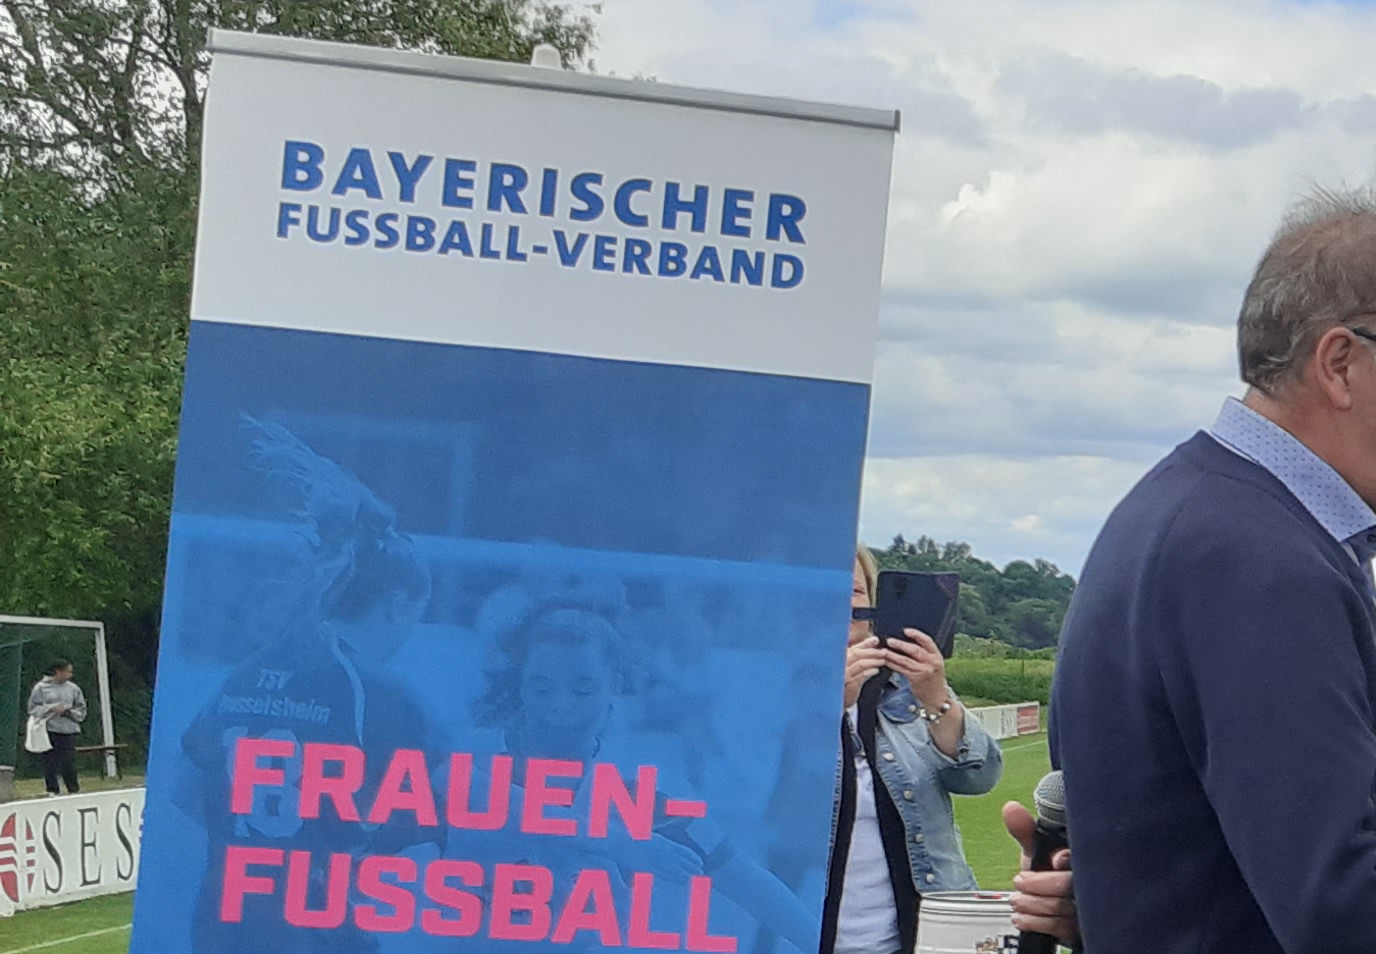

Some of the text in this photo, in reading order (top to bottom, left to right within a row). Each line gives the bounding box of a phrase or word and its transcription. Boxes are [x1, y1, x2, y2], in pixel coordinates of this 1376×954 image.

[281, 140, 807, 244] BAYERISCHER
[277, 203, 805, 289] FUSSBALL-VERBAND
[231, 737, 707, 842] FRAUEN-
[220, 846, 738, 953] FUSSBALL
